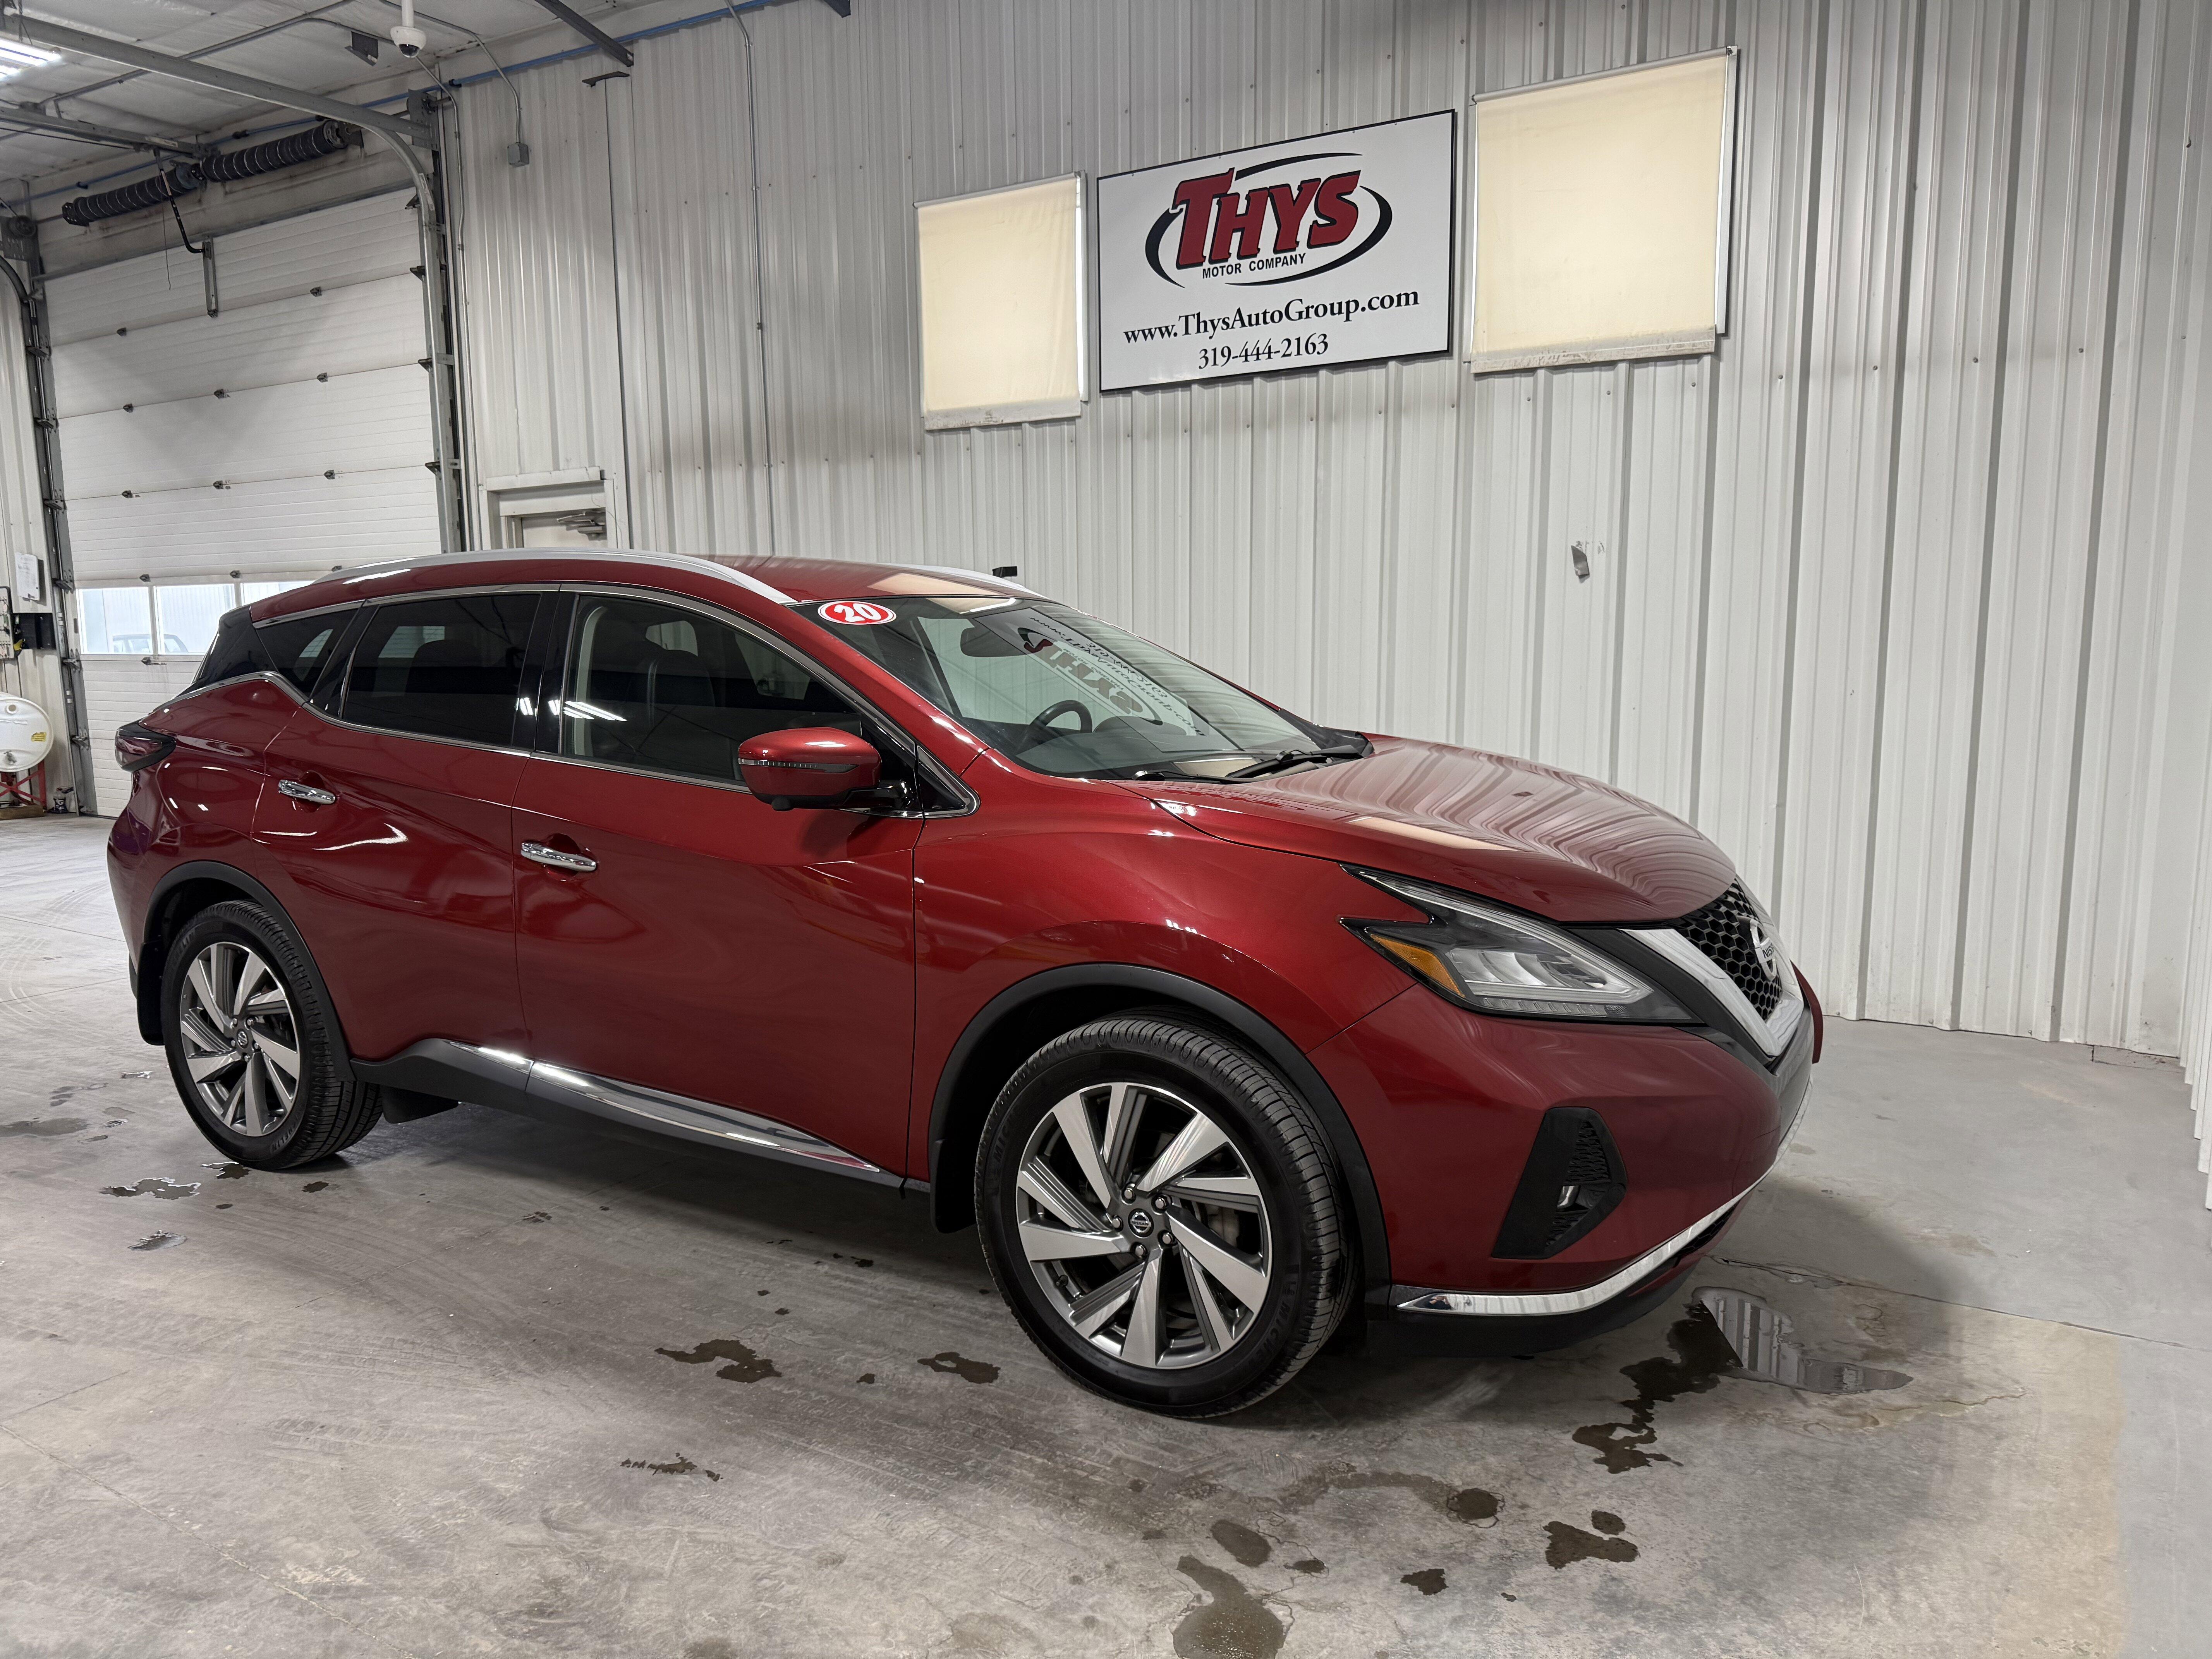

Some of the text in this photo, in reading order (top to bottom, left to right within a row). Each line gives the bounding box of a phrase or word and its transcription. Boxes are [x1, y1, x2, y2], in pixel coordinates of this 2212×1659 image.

[1169, 168, 1361, 270] THYS
[1202, 252, 1306, 279] MOTOR COMPANY
[1123, 290, 1420, 344] www.ThysAutoGroup.com
[1198, 333, 1329, 369] 319-444-2163
[834, 603, 881, 623] 20
